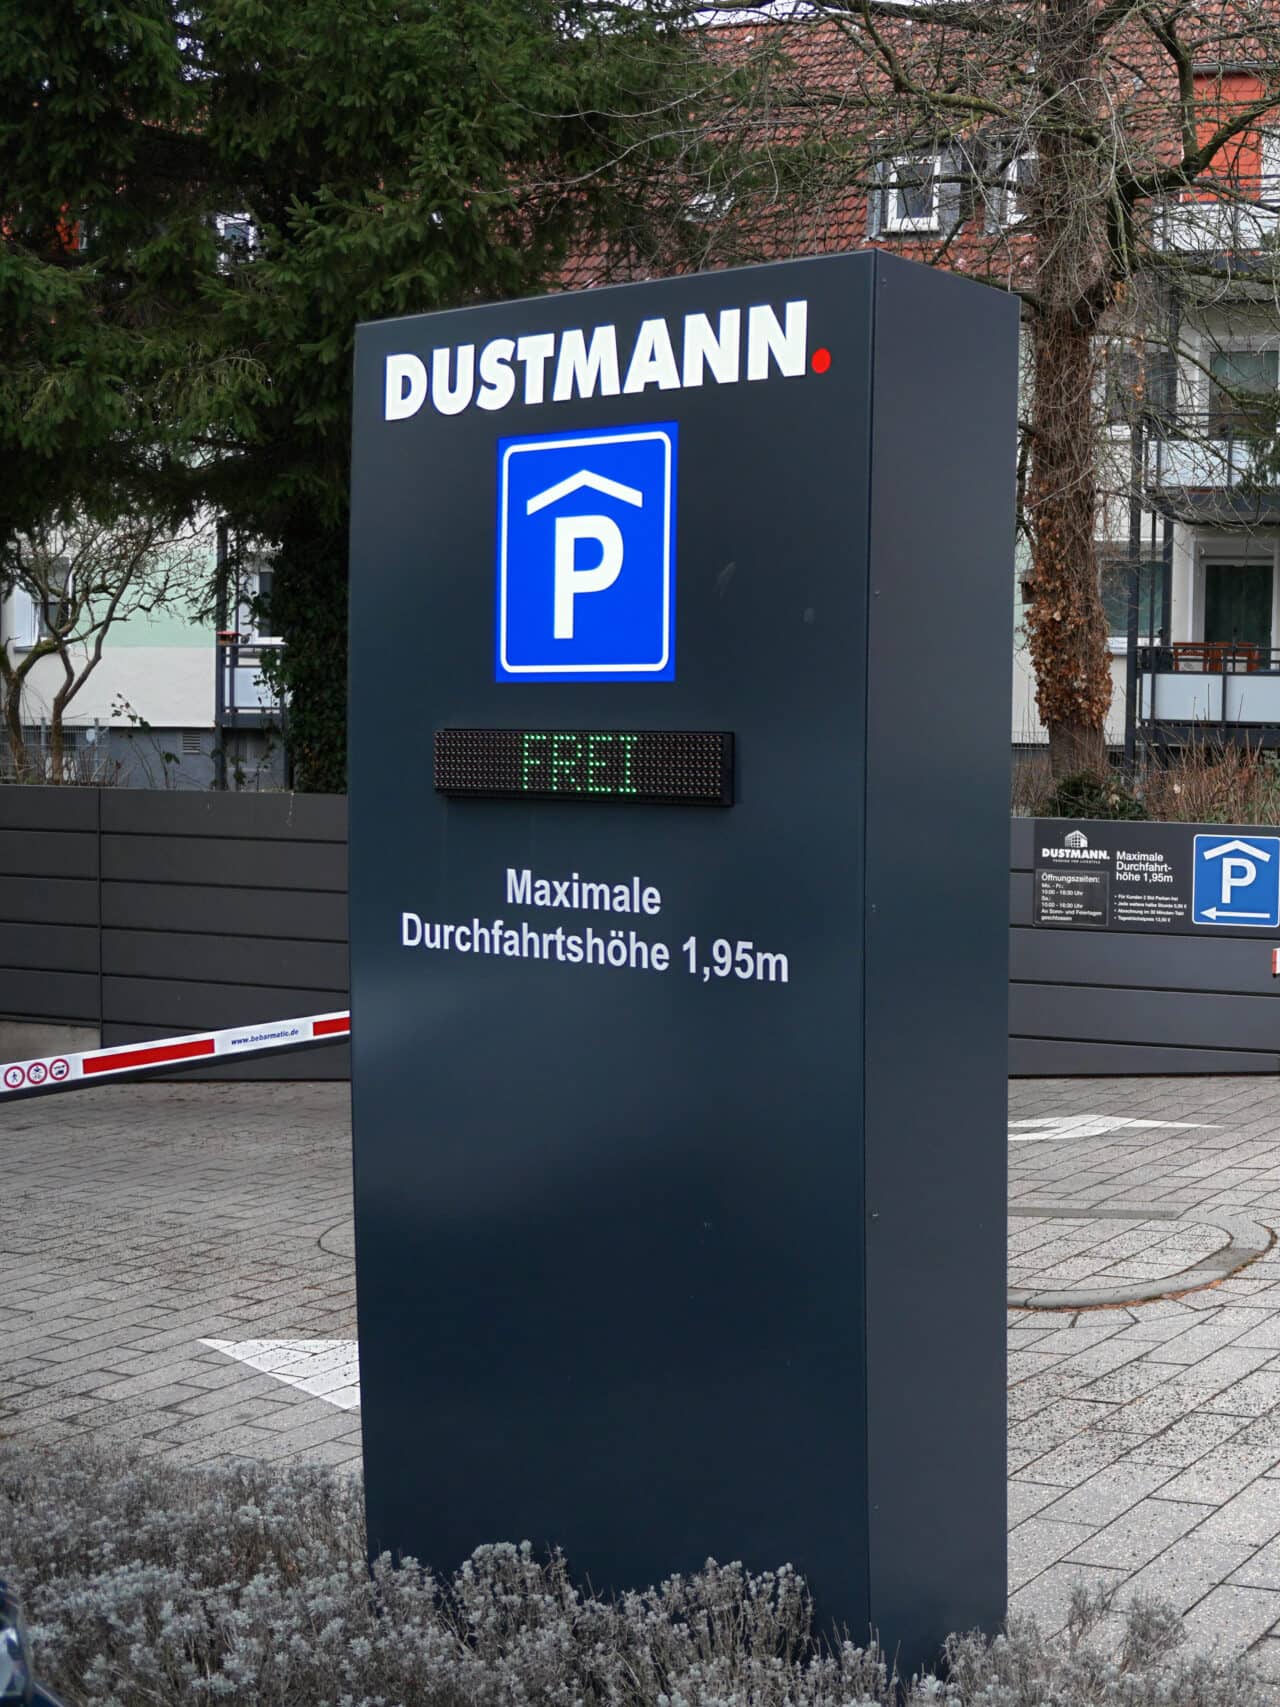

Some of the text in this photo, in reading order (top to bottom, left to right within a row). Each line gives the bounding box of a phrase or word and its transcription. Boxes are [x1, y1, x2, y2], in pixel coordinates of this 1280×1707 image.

[383, 299, 832, 421] DUSTMANN.
[553, 515, 624, 640] P
[522, 734, 638, 793] FREI
[1041, 848, 1111, 861] DUSTMANN.
[1041, 872, 1101, 884] Öffnungszeiten:
[1116, 851, 1164, 862] Maximale
[1116, 861, 1173, 873] Durchfahrt-
[1116, 872, 1174, 883] höhe 1,95m
[506, 868, 662, 916] Maximale
[1221, 857, 1257, 904] P
[401, 912, 789, 983] Durchfahrtshöhe 1,95m
